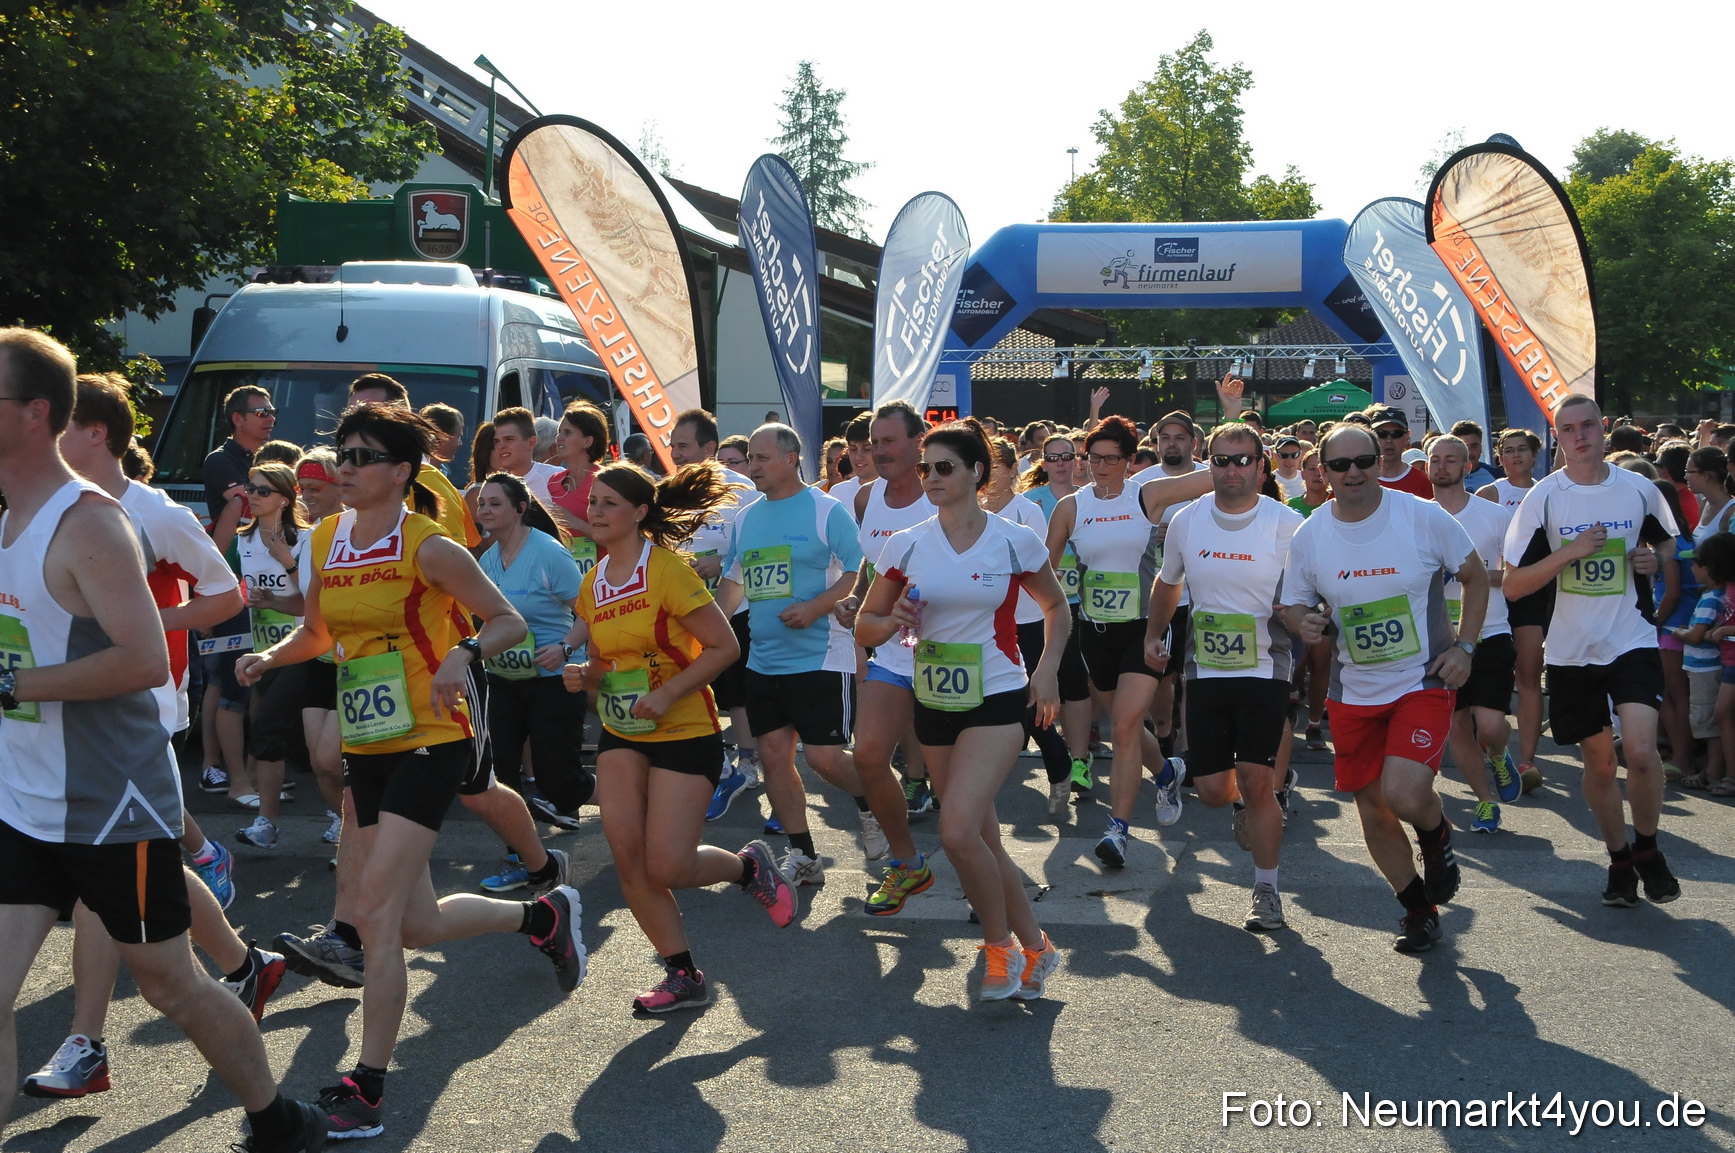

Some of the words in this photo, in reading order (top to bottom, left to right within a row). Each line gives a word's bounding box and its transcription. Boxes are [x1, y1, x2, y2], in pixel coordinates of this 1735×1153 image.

[427, 244, 452, 254] 1628
[1163, 246, 1196, 254] Fischer
[1138, 263, 1237, 281] firmenlauf
[900, 222, 951, 354] Fischer
[920, 247, 954, 352] AUTOMOBILE
[955, 299, 1004, 309] Fischer
[1096, 514, 1134, 522] KLEBL
[1212, 551, 1256, 562] KLEBL
[258, 574, 287, 587] RSC
[323, 575, 355, 590] MAX
[359, 567, 402, 585] BÖGL
[744, 563, 789, 589] 1375
[1353, 567, 1401, 578] KLEBL
[1570, 558, 1616, 582] 199
[1092, 588, 1131, 610] 527
[593, 608, 617, 624] MAX
[619, 599, 650, 616] BÖGL
[253, 624, 293, 644] 1196
[1203, 631, 1247, 655] 534
[1355, 619, 1404, 650] 559
[922, 665, 969, 695] 120
[342, 684, 396, 725] 826
[601, 692, 639, 720] 767
